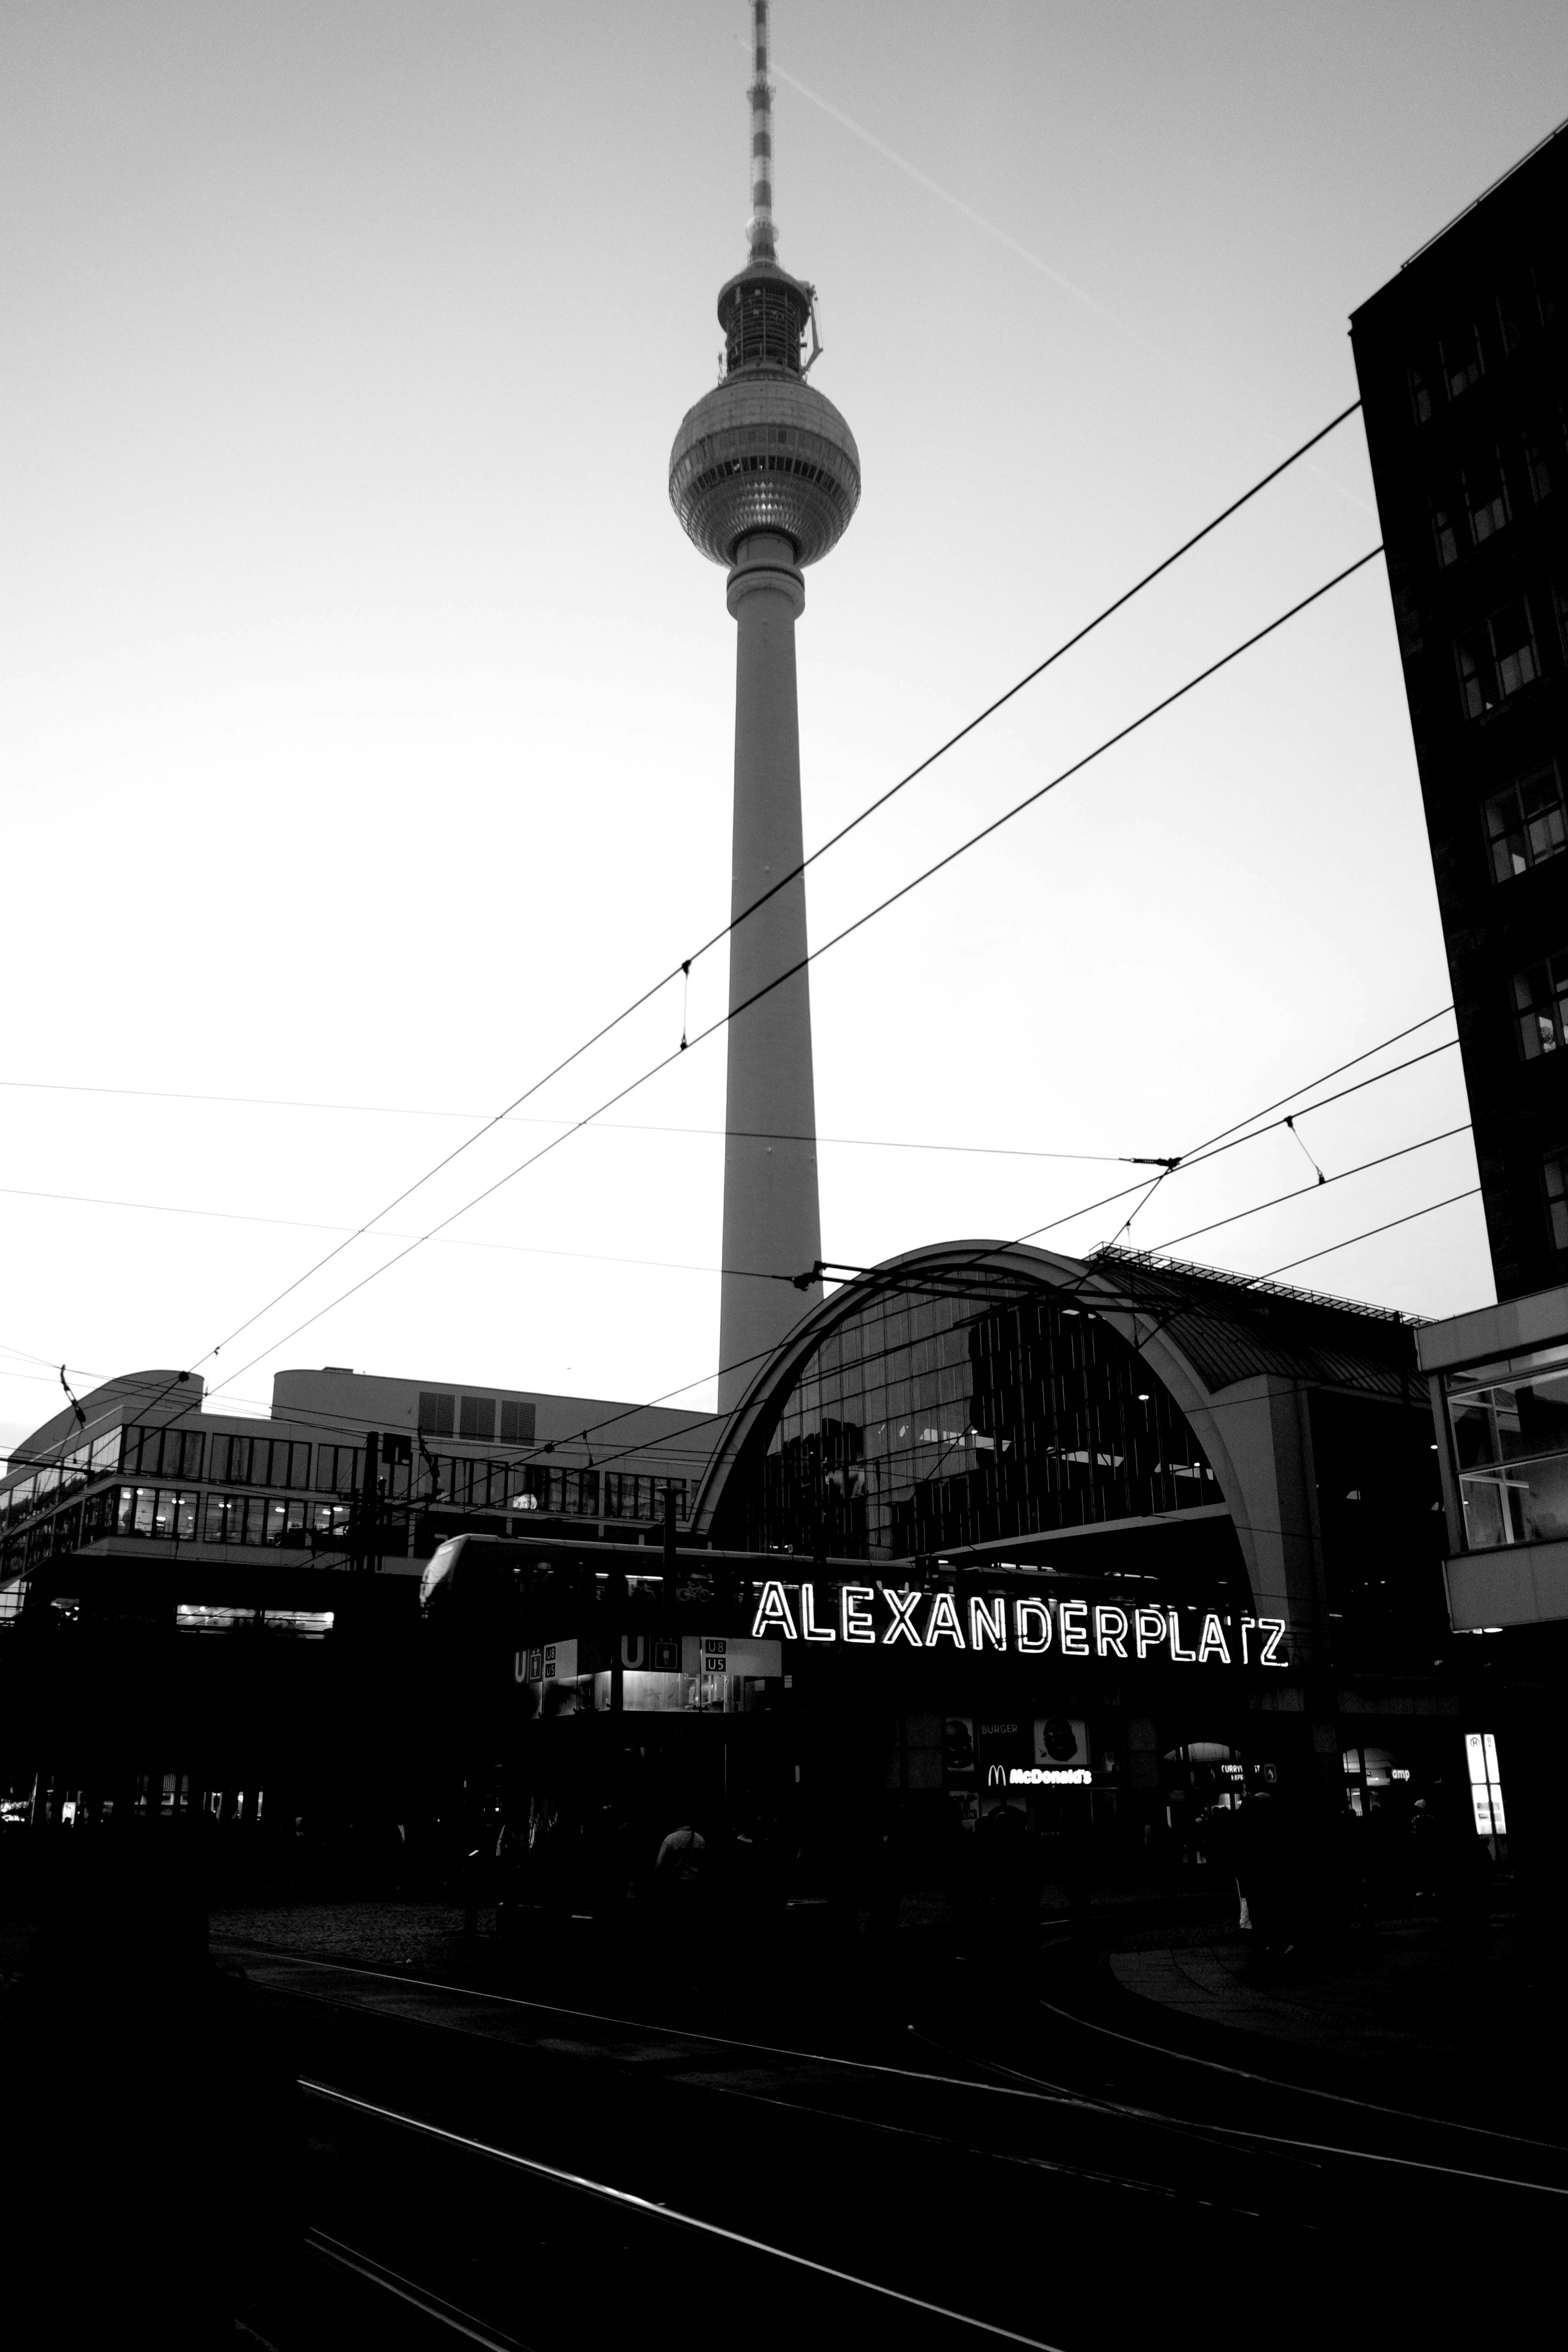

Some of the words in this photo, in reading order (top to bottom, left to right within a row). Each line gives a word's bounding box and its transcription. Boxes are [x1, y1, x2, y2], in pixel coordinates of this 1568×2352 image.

[622, 1635, 644, 1668] U
[708, 1641, 724, 1652] U8
[547, 1648, 555, 1659] U8
[515, 1651, 526, 1682] U
[708, 1659, 724, 1670] U5
[546, 1665, 554, 1676] U5
[982, 1724, 1018, 1734] BURGER
[1009, 1768, 1092, 1784] McDonald's
